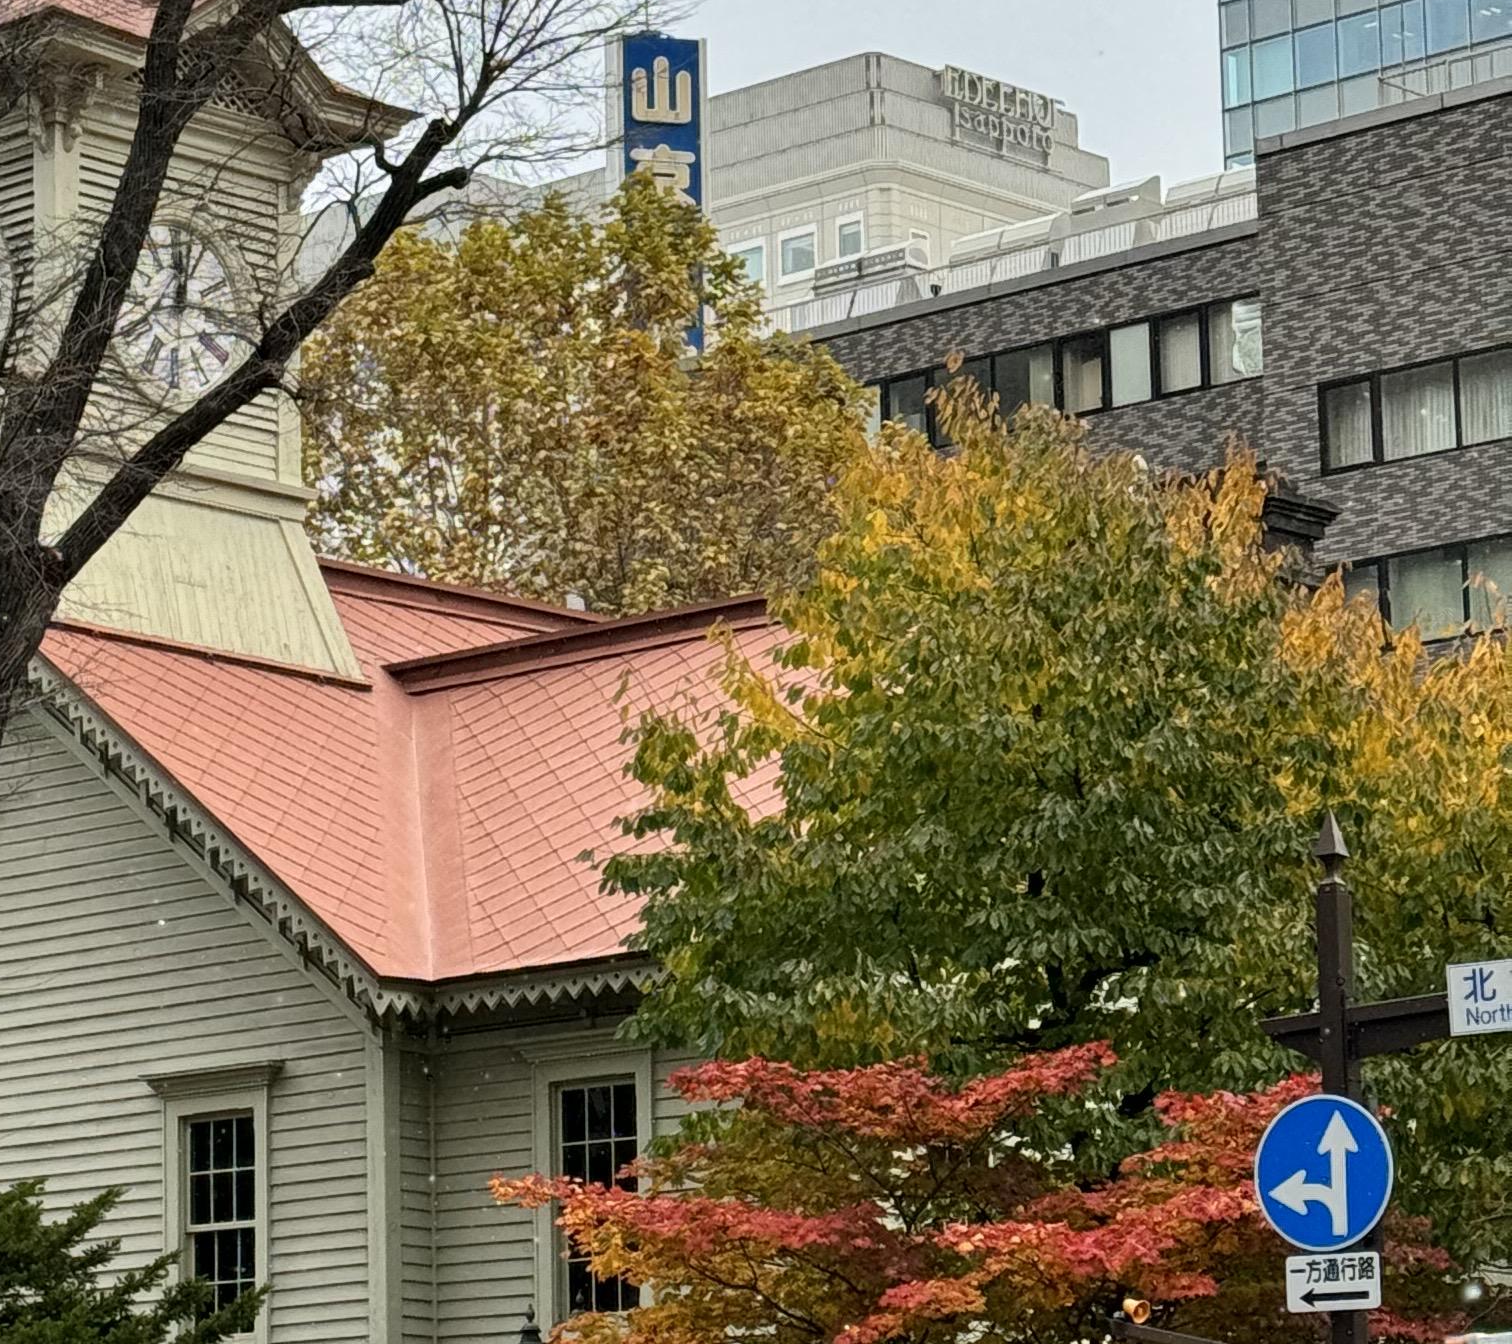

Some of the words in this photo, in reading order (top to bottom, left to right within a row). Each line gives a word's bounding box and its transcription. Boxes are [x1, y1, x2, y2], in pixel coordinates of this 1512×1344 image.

[1289, 1256, 1375, 1284] 一方通行路
